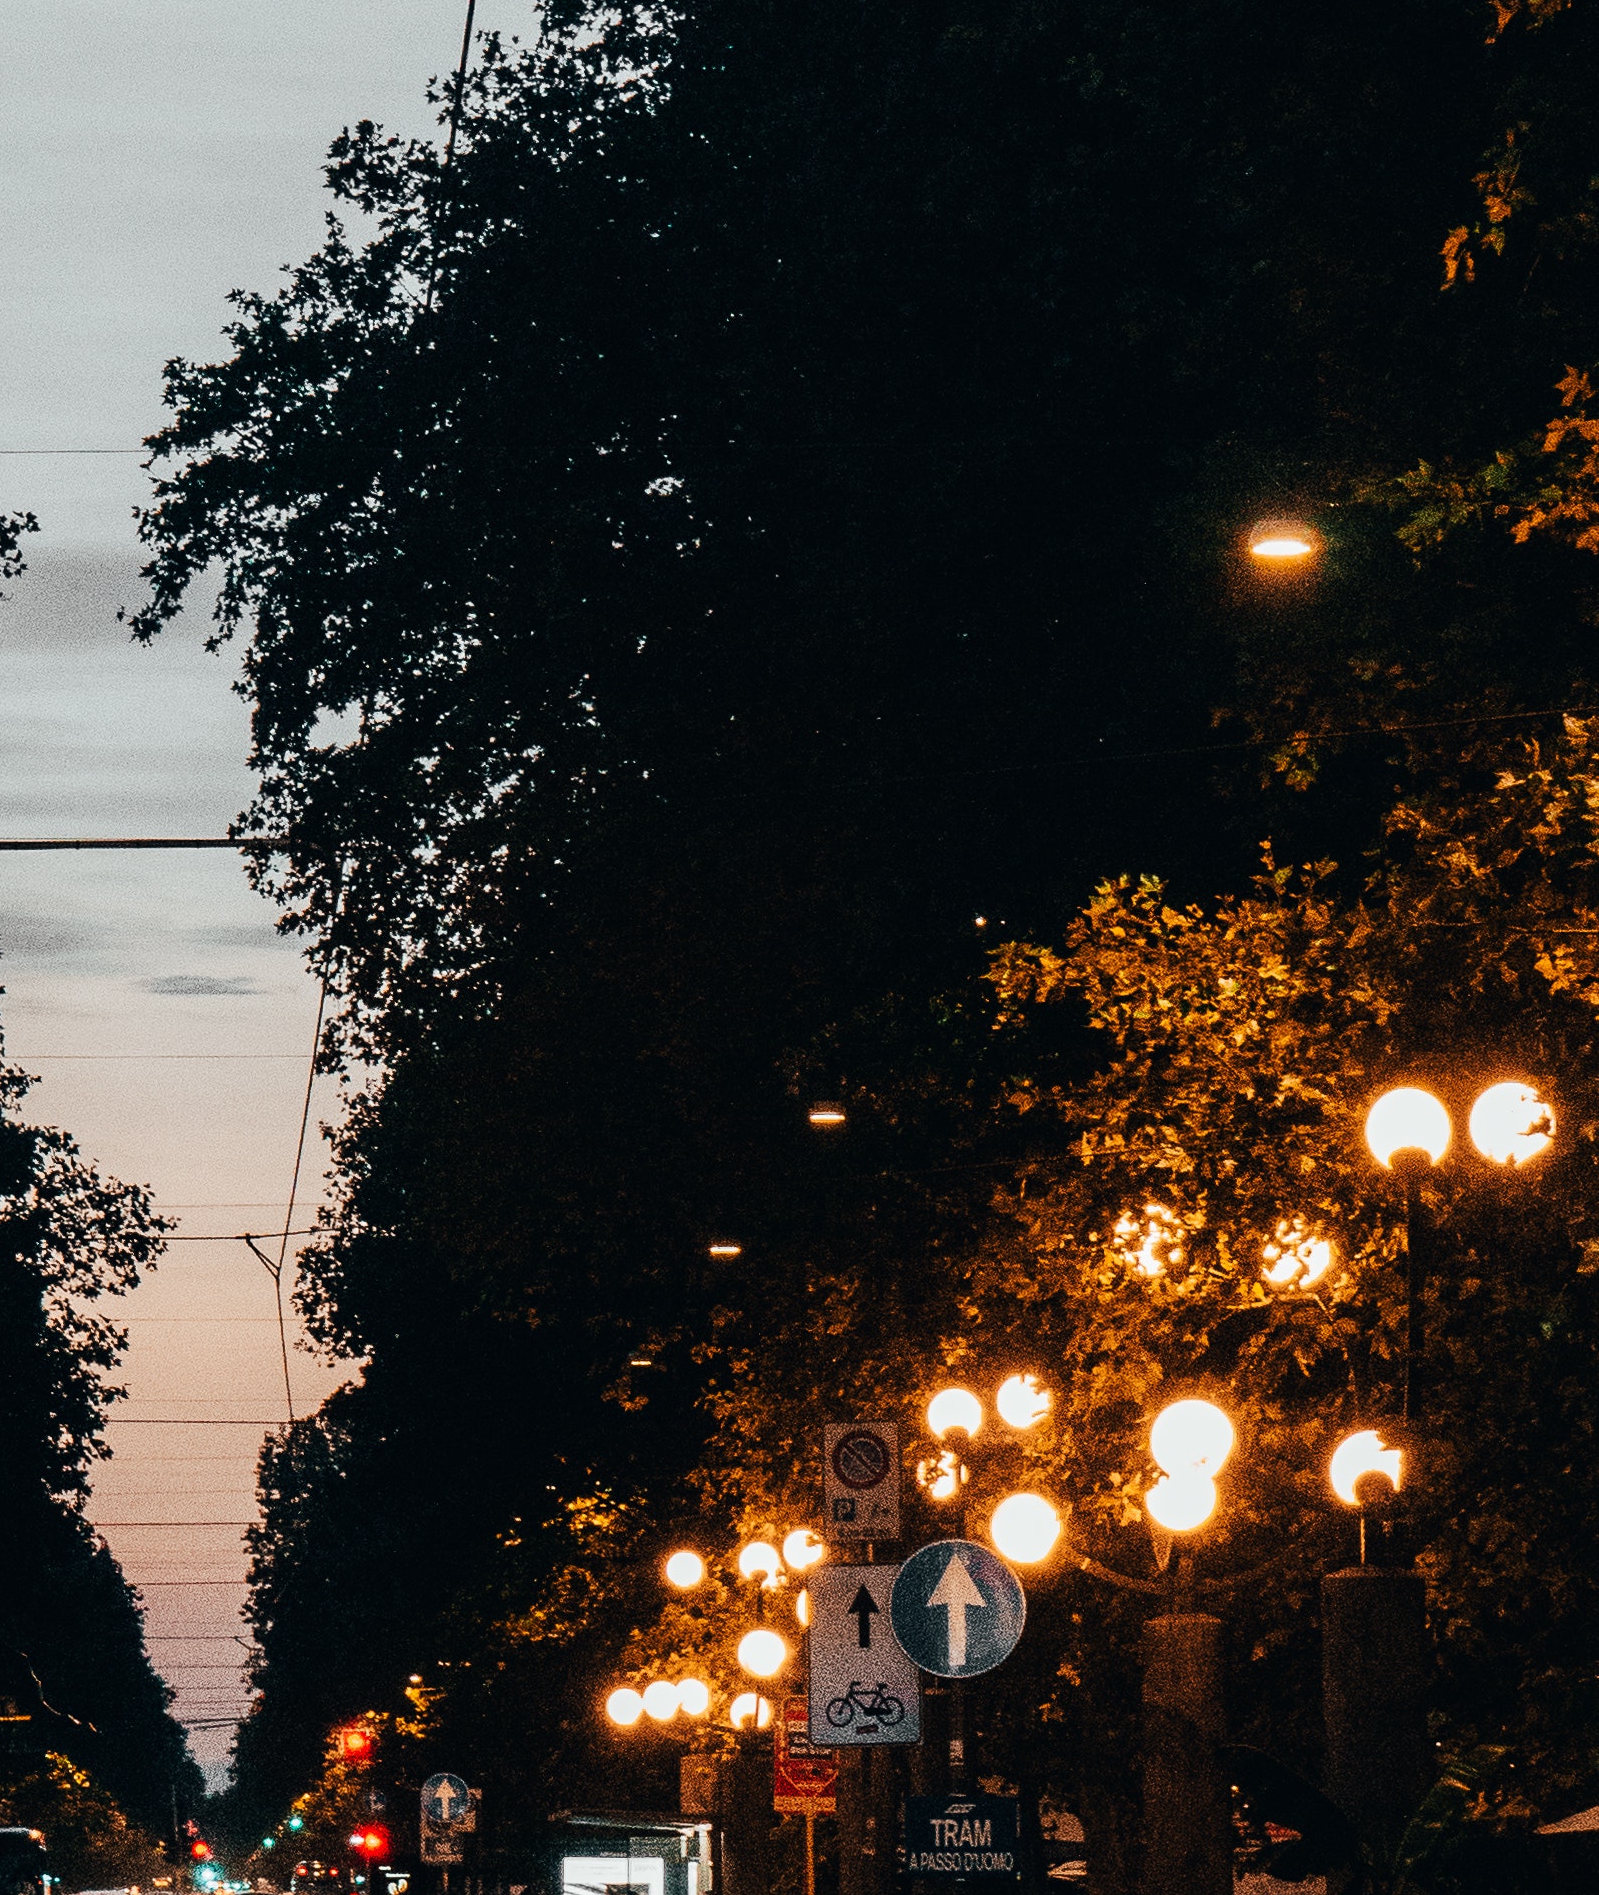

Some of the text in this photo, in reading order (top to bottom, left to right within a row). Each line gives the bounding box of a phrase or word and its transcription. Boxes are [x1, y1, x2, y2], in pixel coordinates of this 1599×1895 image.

[929, 1819, 992, 1847] TRAM
[909, 1852, 1014, 1871] A PASSO D'UOMO
